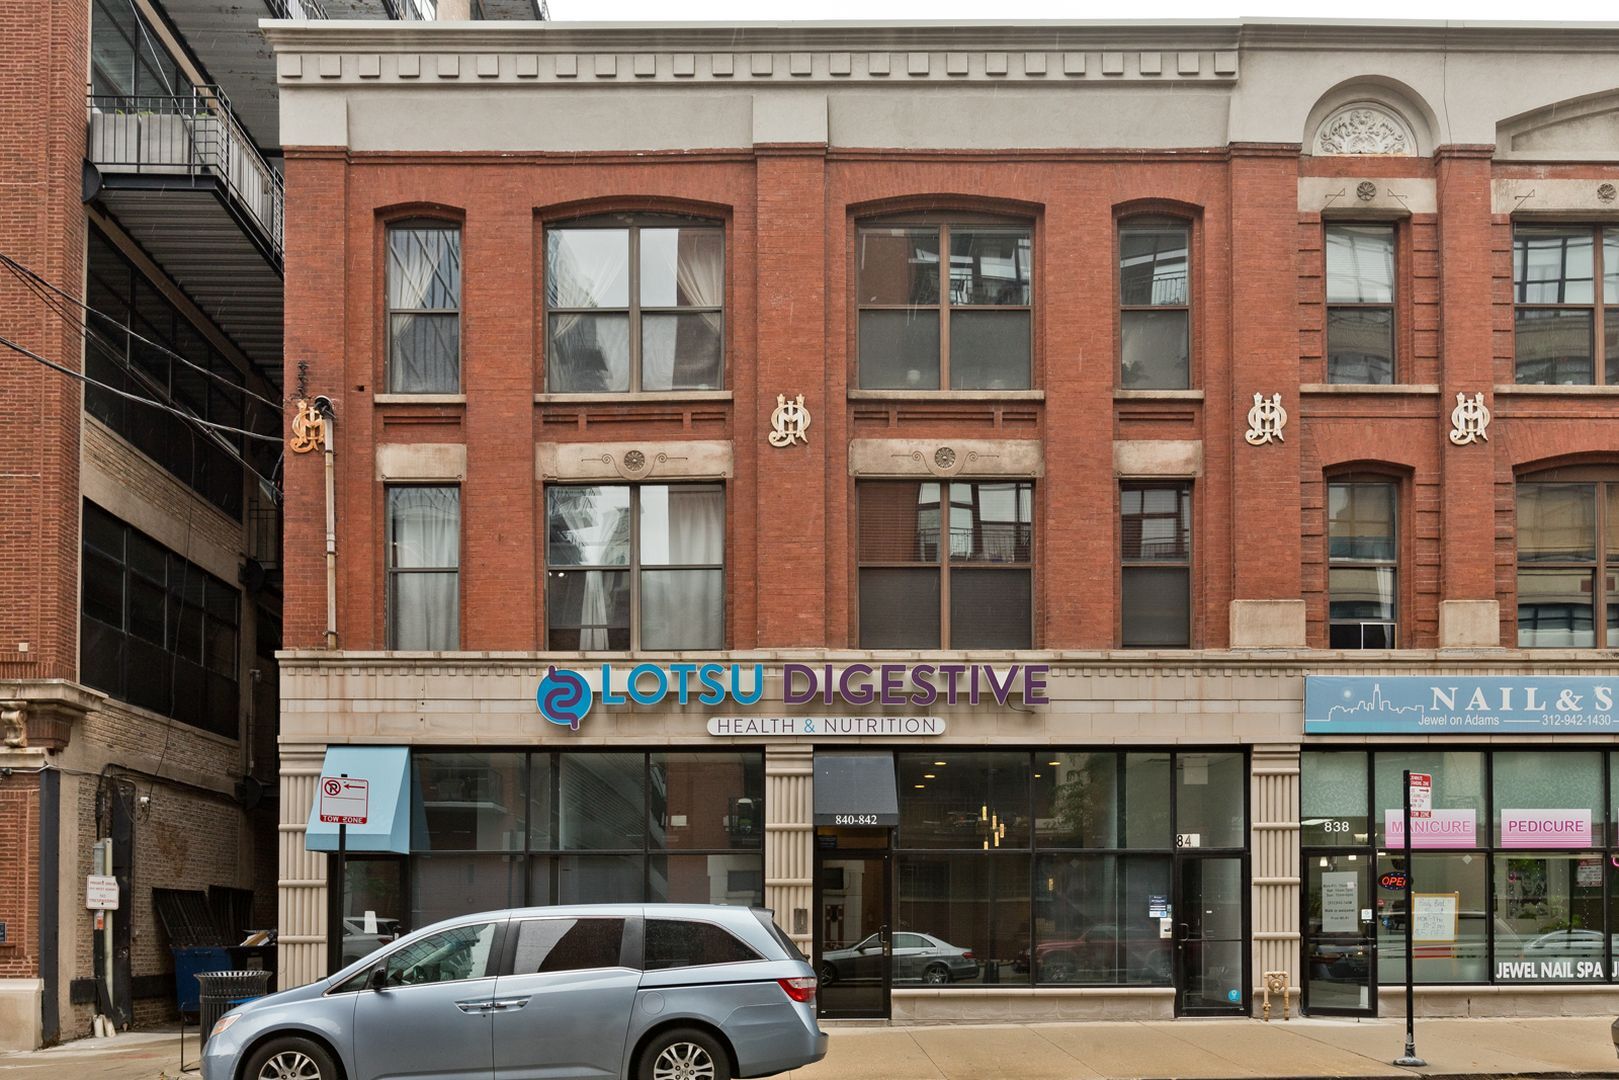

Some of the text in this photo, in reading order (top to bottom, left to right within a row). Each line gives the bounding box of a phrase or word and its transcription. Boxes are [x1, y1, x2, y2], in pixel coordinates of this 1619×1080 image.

[601, 663, 1050, 705] LOTSU DIGESTIVE
[717, 718, 935, 733] HEALTH & NUTRITION
[1418, 714, 1611, 726] Jewel on Adams 312-942-1430
[342, 816, 363, 824] ZONE
[835, 814, 878, 825] 840-842
[1324, 821, 1350, 833] 838
[1391, 820, 1472, 833] MNICURE
[1508, 820, 1585, 832] PEDICURE
[1496, 961, 1604, 979] JEWEL NAIL SPA
